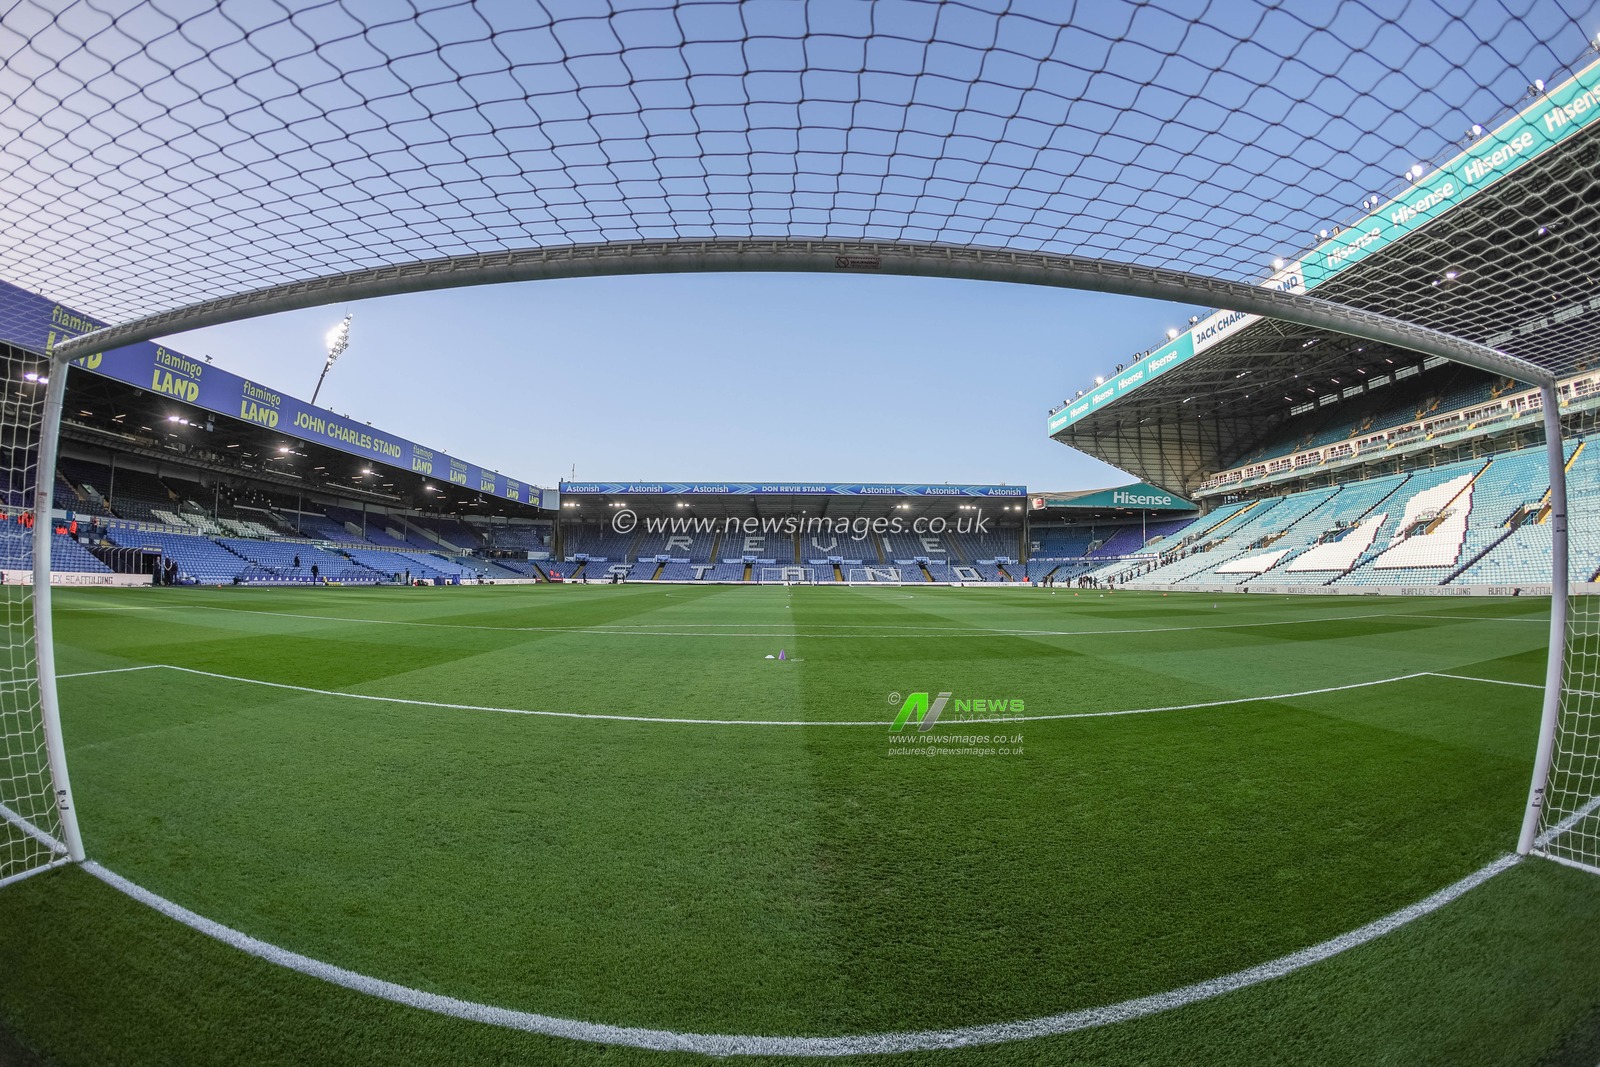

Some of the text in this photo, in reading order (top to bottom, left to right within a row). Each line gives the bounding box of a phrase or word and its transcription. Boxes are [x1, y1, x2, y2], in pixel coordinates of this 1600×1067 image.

[1543, 84, 1600, 132] Hisens
[1463, 131, 1534, 184] Hisense
[1391, 182, 1454, 228] Hisense
[1326, 226, 1381, 268] Hisense
[53, 305, 101, 332] flamin
[1196, 324, 1217, 345] JACK
[45, 331, 102, 369] LD
[156, 346, 202, 378] flamingo
[1148, 350, 1178, 373] Hisense
[152, 369, 199, 402] LAND
[1118, 370, 1144, 390] Hisense
[243, 380, 281, 407] flamingo
[1092, 388, 1115, 405] Hisense
[240, 400, 279, 428] LAND
[1070, 403, 1089, 418] Hisense
[1506, 415, 1536, 428] Hisense
[294, 411, 401, 459] JOHN CHARLES STAND
[412, 457, 432, 475] LAND
[450, 470, 467, 485] LAND
[481, 480, 495, 493] LAND
[566, 484, 600, 492] Astonish
[628, 484, 663, 493] Astonish
[692, 484, 729, 493] Astonish
[860, 485, 896, 494] Astonish
[925, 486, 960, 495] Astonish
[988, 487, 1022, 496] Astonish
[1113, 491, 1172, 506] Hisense
[66, 575, 113, 585] SCAFFOLDING
[1429, 587, 1471, 595] SCAFFOLDING
[1488, 587, 1514, 596] BURFLE
